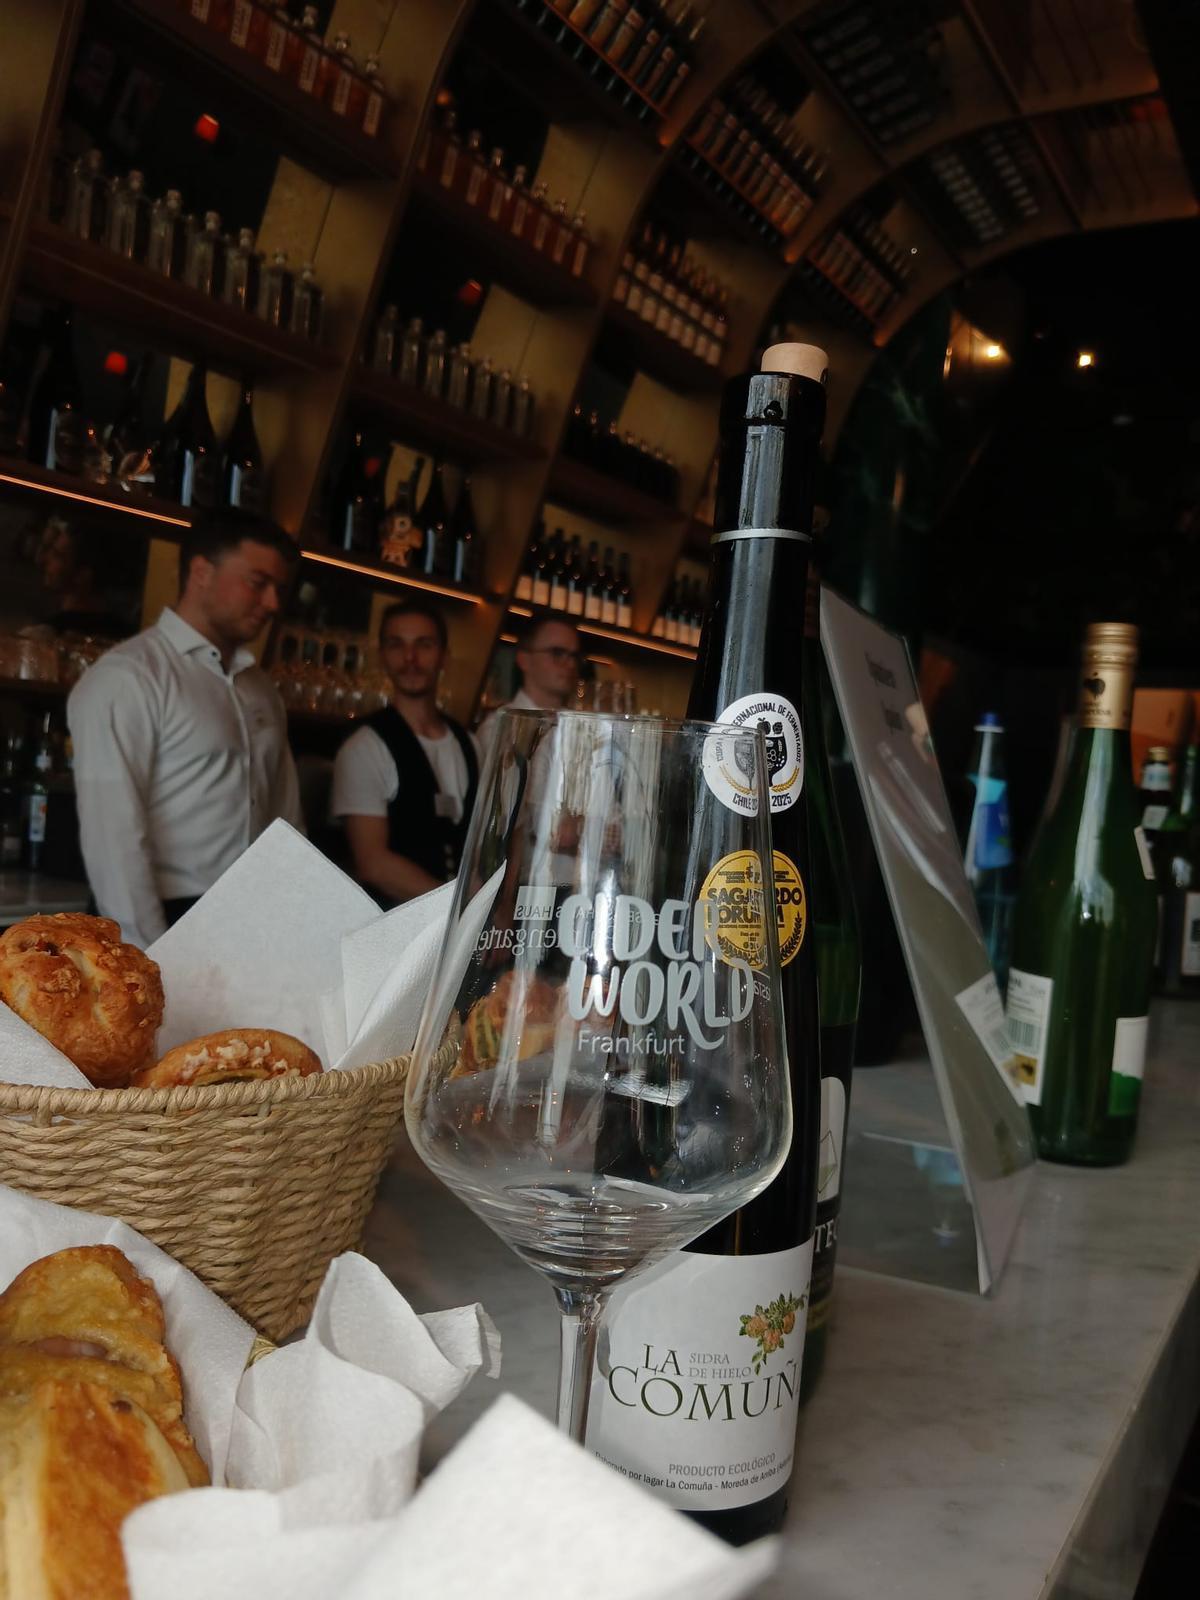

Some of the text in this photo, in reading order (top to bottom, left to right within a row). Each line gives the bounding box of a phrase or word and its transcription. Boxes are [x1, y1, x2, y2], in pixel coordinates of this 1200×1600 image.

[731, 702, 777, 727] ERNACIONAL
[777, 704, 787, 717] DE
[771, 792, 793, 807] 2025
[707, 887, 803, 906] SAGADO
[557, 891, 723, 962] CIDER
[566, 956, 754, 1050] WORLD
[577, 1029, 685, 1055] Frankfurt
[642, 1343, 684, 1377] LA
[688, 1352, 730, 1365] SIDRA
[688, 1366, 752, 1380] DE HIELO
[608, 1358, 800, 1421] COMUÑ
[668, 1463, 726, 1477] PRODUCTO
[728, 1452, 776, 1475] ECOLÓGICO
[628, 1469, 642, 1481] por
[643, 1473, 664, 1487] lagar
[666, 1479, 676, 1489] La
[678, 1480, 713, 1491] Comuña
[720, 1478, 749, 1489] Moreda
[750, 1475, 759, 1484] de
